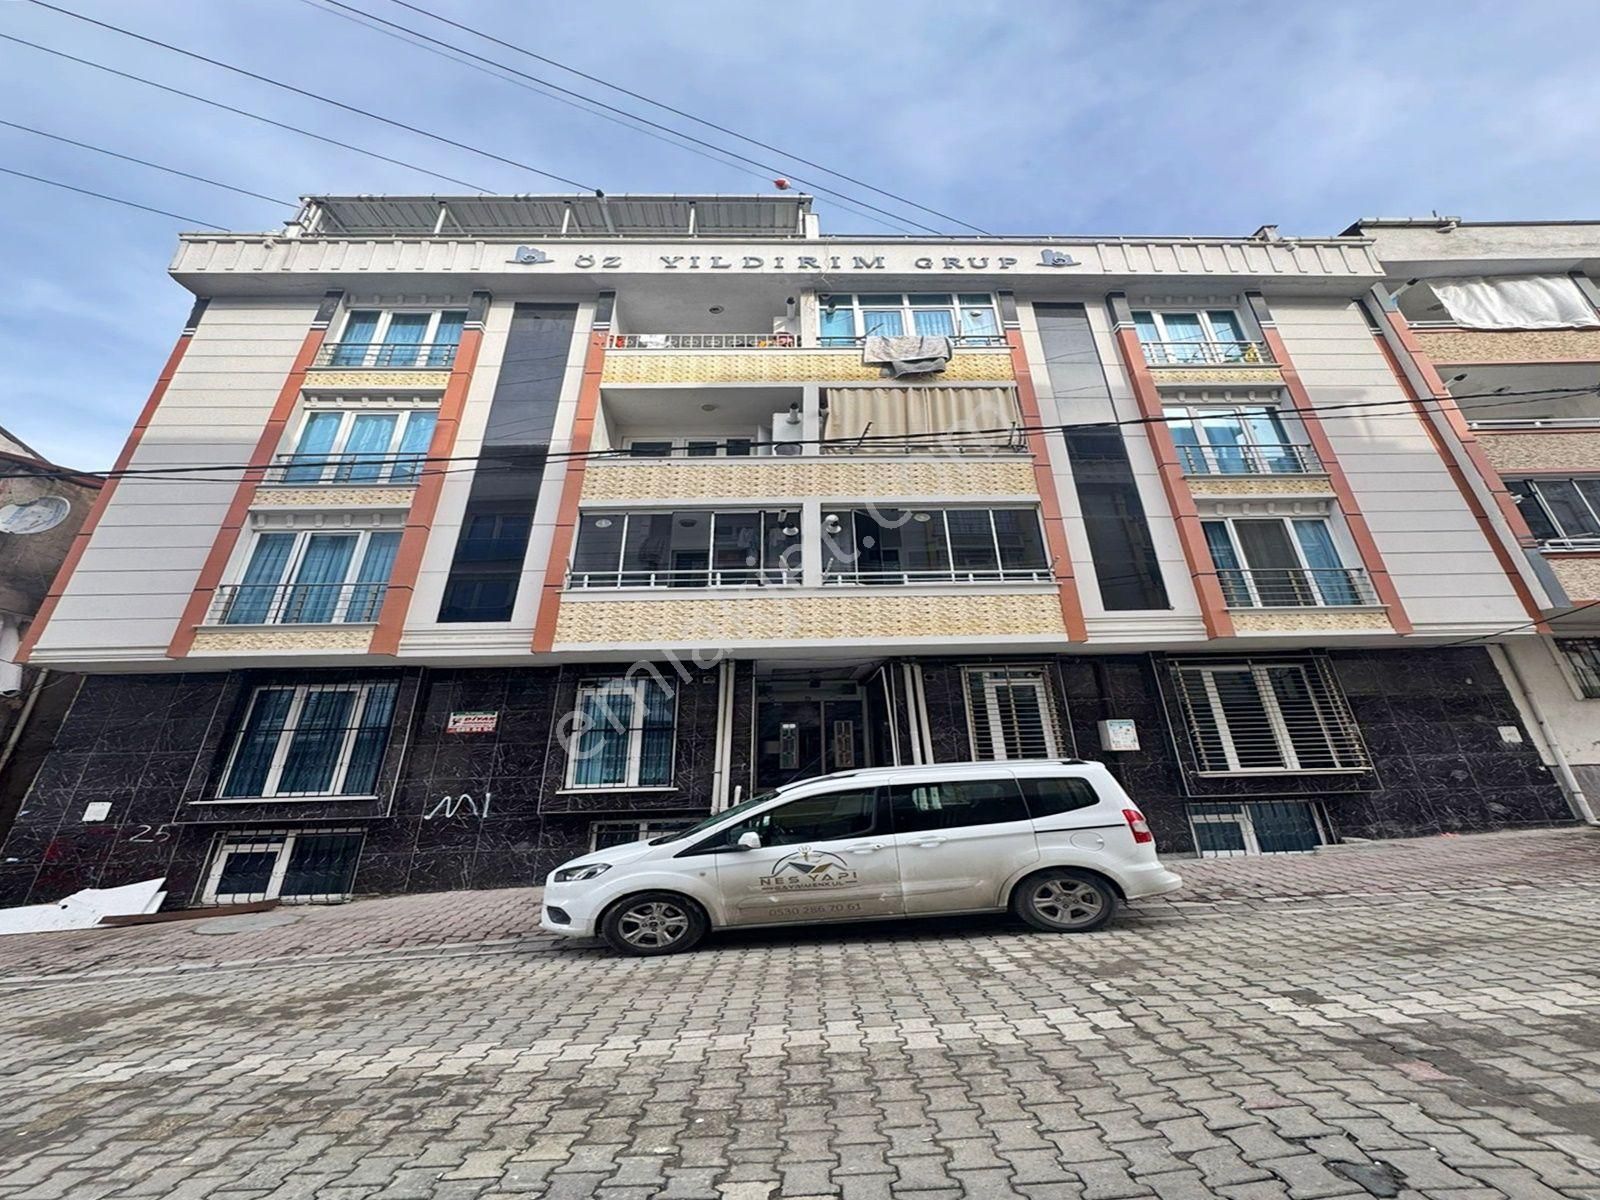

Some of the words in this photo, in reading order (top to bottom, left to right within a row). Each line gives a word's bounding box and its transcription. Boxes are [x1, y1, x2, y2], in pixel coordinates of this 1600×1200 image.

[575, 254, 622, 269] ÖZ
[660, 255, 887, 270] YILDIRIM
[914, 256, 1018, 270] GRUP
[129, 824, 171, 843] 25
[760, 876, 799, 886] NES
[808, 871, 857, 882] YAPI
[768, 907, 799, 917] 0530
[847, 903, 861, 911] 61
